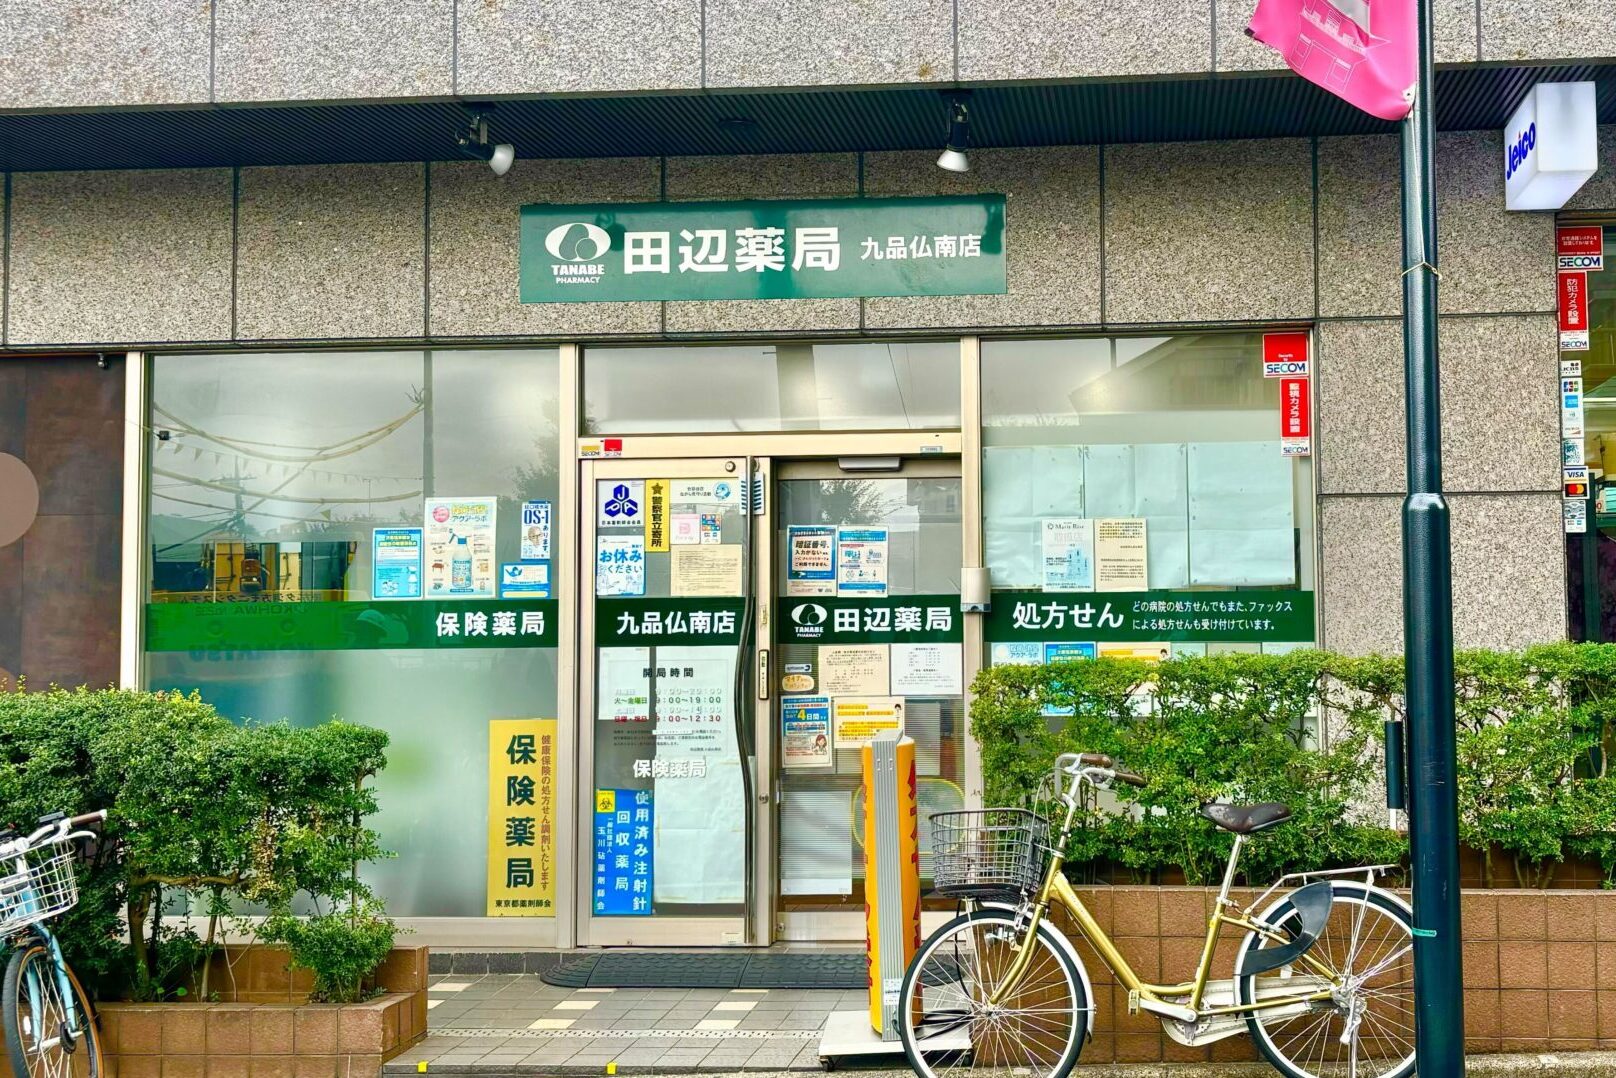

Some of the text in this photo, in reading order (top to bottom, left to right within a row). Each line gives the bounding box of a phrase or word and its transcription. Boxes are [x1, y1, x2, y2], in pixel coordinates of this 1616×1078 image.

[1507, 122, 1536, 180] Jeico
[624, 227, 981, 274] 田辺薬局 九品仏南店
[1560, 257, 1600, 267] SECOM
[551, 264, 605, 276] TANABE
[1267, 363, 1306, 373] SECOM
[524, 510, 549, 524] OS-1
[652, 496, 663, 548] 警察官立寄所
[600, 549, 642, 564] お休み
[608, 565, 642, 574] ください
[1012, 601, 1124, 629] 処方せん
[1132, 600, 1292, 613] どの病院の処方せんでもまた、ファックス
[436, 611, 544, 637] 保険薬局
[616, 610, 736, 634] 九品仏南店
[834, 607, 952, 632] 田辺薬局
[1132, 618, 1275, 630] による処方せんも受け付けています。
[642, 668, 694, 678] 開局時間
[633, 759, 706, 778] 保険薬局
[506, 734, 537, 888] 保険薬局
[540, 735, 551, 890] 健康保険の処方せん調剤いたします
[615, 811, 630, 890] 回収薬局
[633, 791, 650, 911] 使用済み注射針
